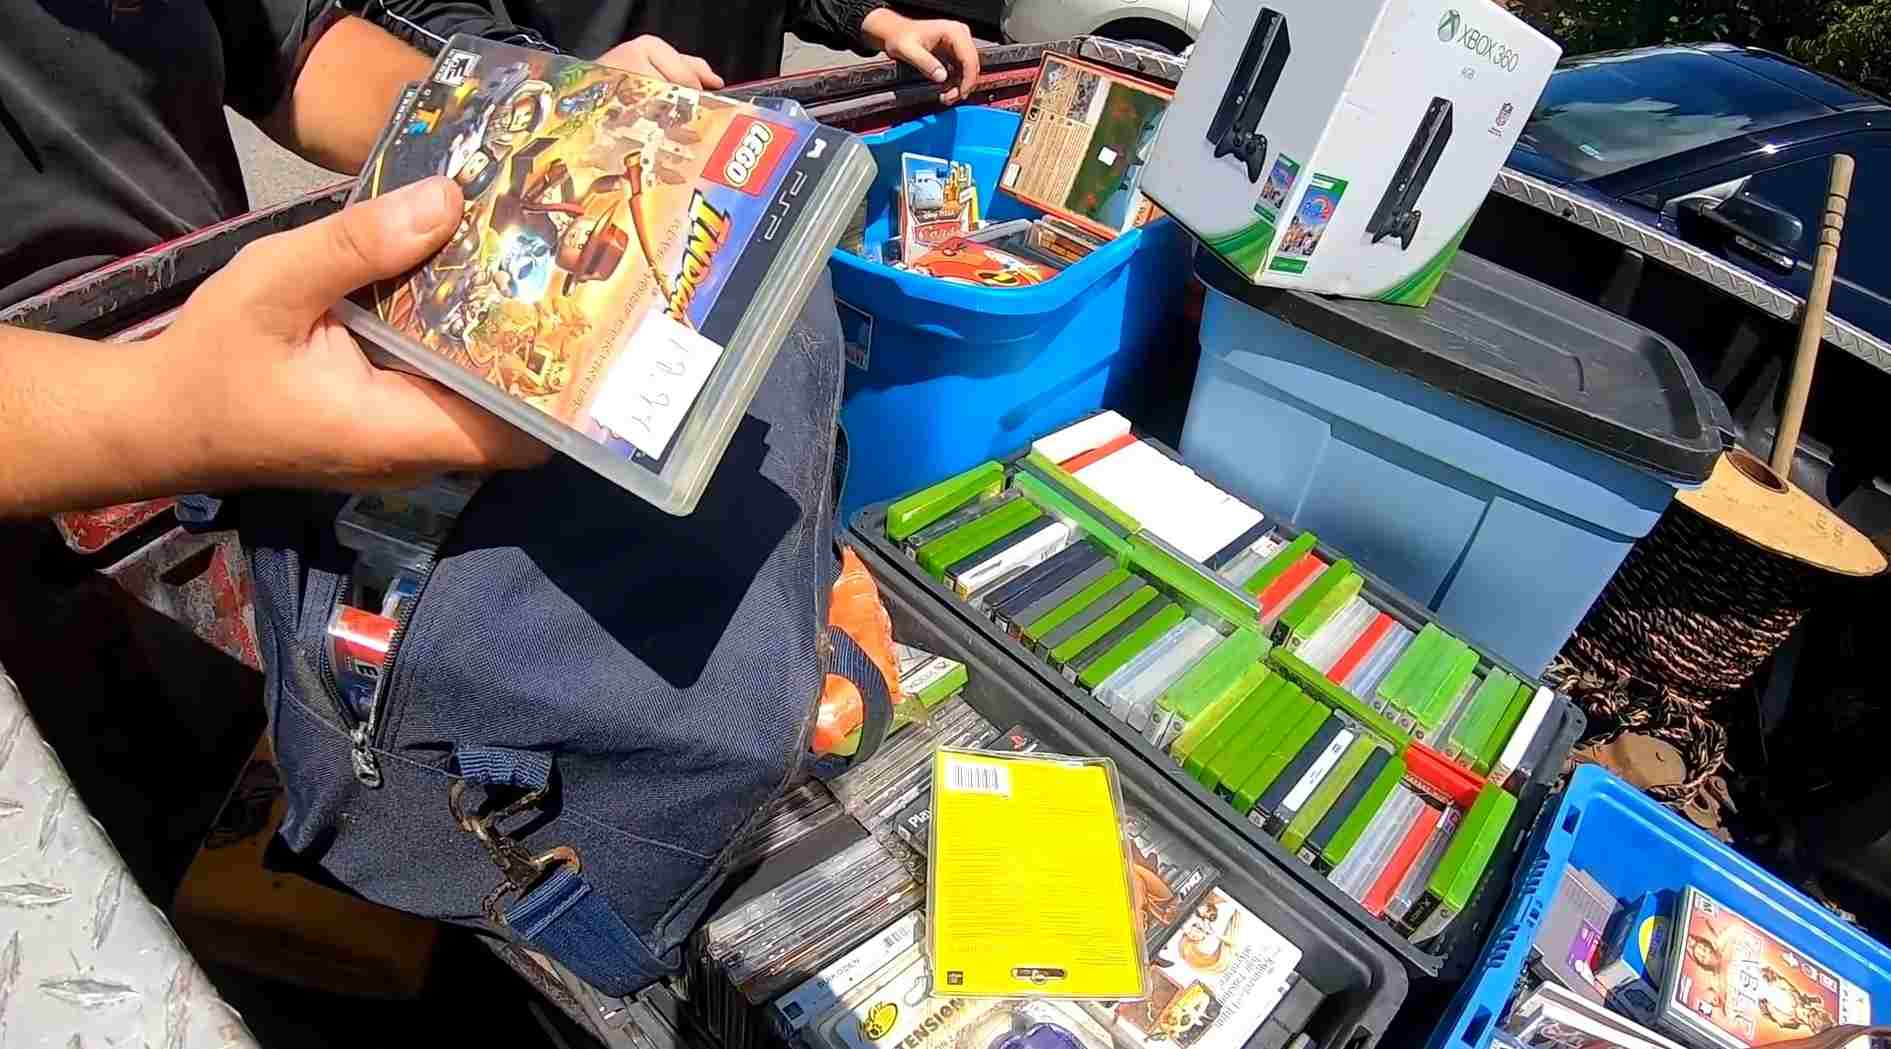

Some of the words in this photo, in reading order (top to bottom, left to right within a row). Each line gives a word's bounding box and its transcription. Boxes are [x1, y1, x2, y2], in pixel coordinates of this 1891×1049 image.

[1457, 23, 1496, 61] XBOX
[1493, 44, 1519, 73] 360
[728, 122, 772, 191] LEGO
[764, 166, 810, 241] PSP
[664, 188, 731, 326] INDIAN
